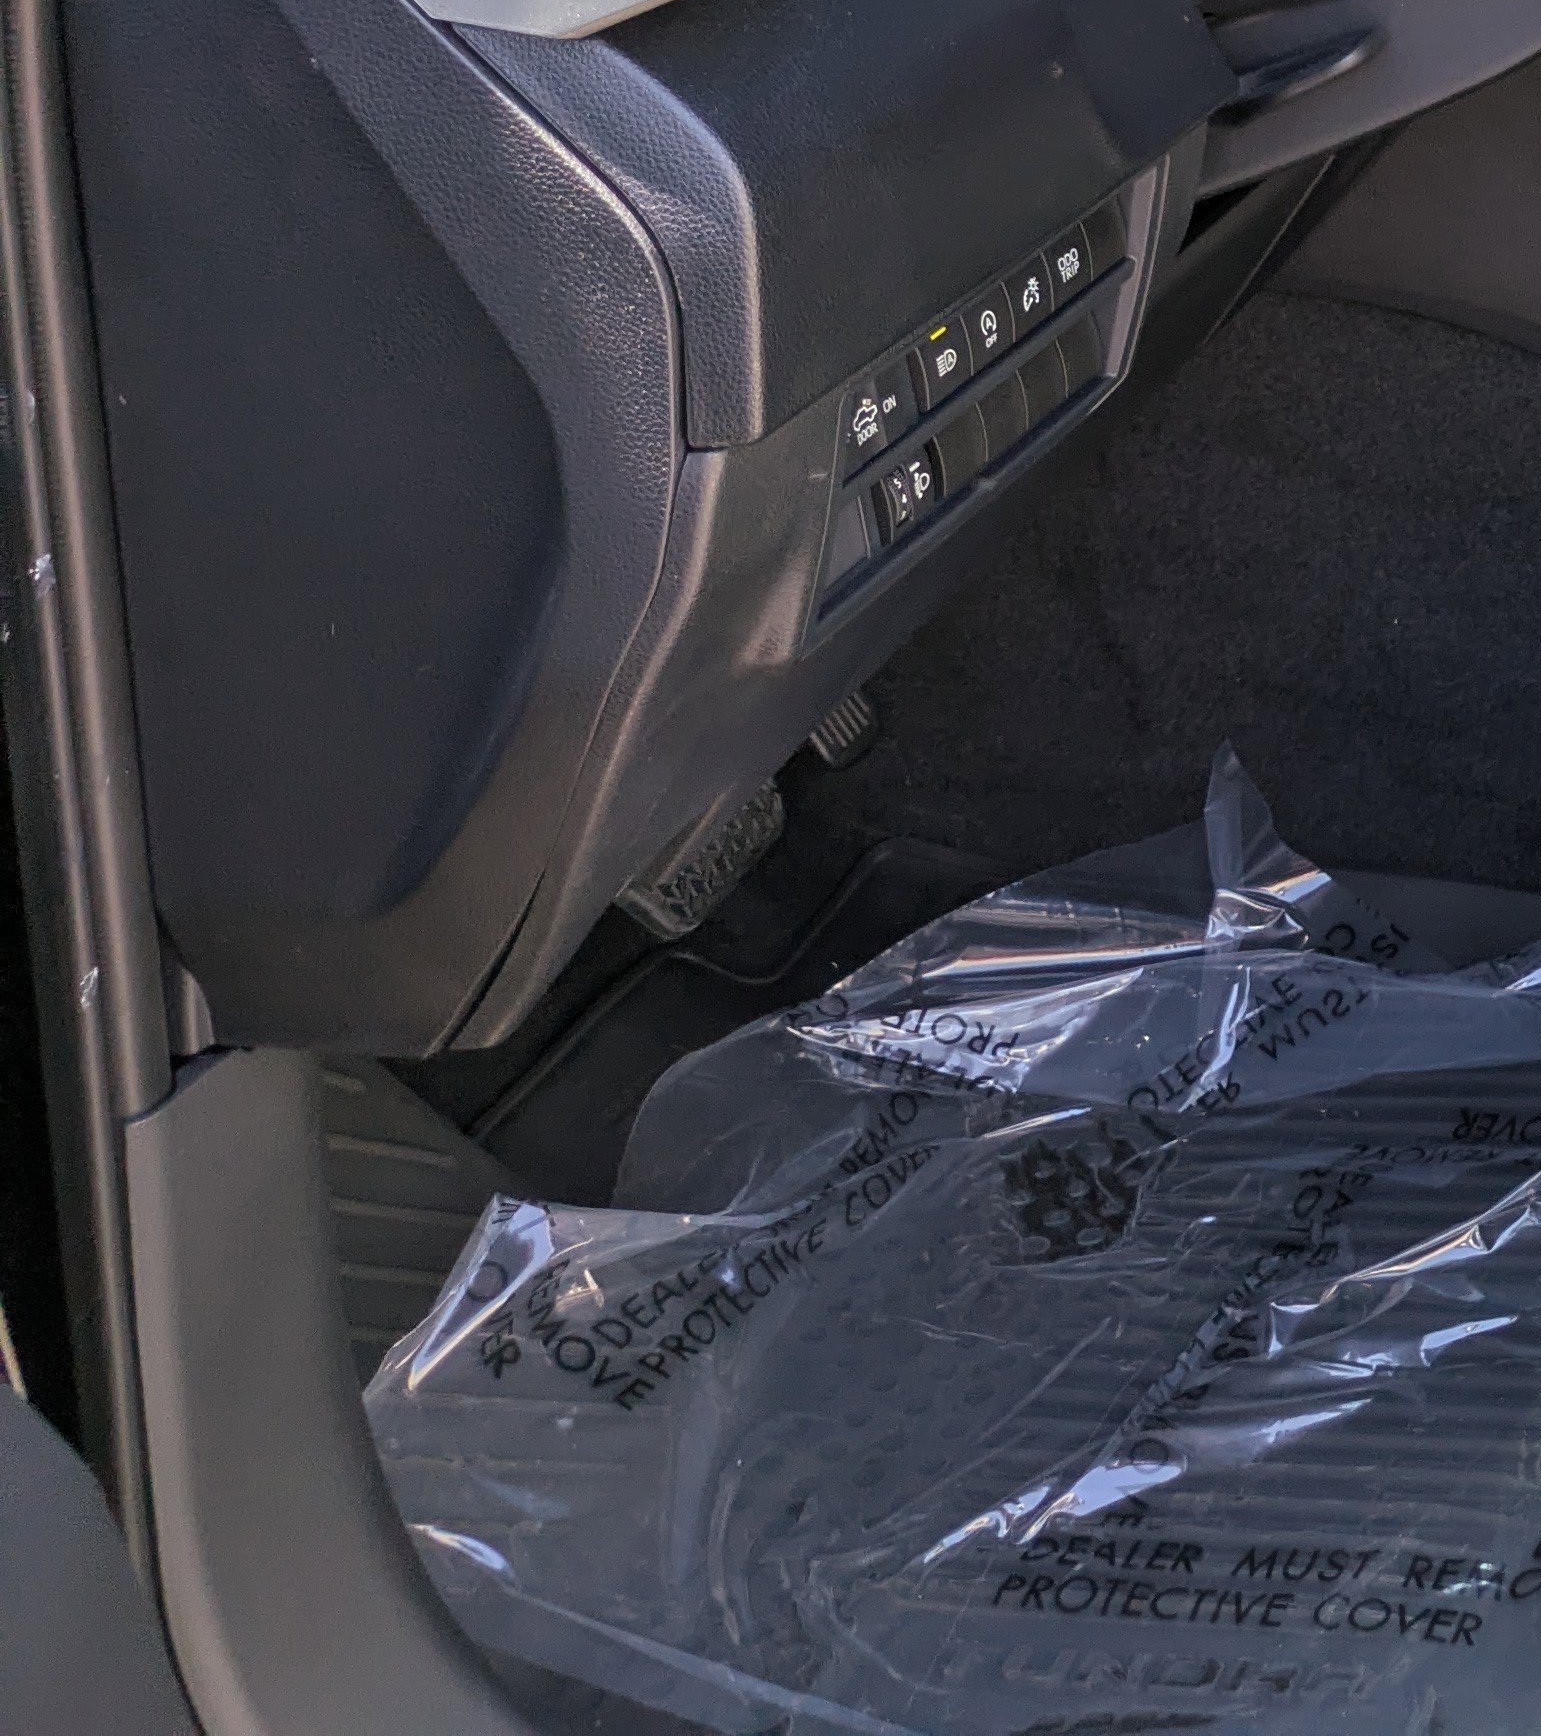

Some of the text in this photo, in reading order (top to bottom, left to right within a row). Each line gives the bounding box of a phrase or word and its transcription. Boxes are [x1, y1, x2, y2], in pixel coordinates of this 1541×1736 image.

[1058, 247, 1078, 271] ODO
[1061, 260, 1080, 283] TRIP
[986, 332, 998, 348] OFF
[883, 394, 897, 413] ON
[857, 422, 879, 446] DOOR
[638, 1218, 828, 1378] PROTECTIVE
[1019, 1533, 1205, 1574] DEALER
[1230, 1545, 1382, 1583] MUST
[992, 1571, 1484, 1647] PROTECTIVE COVER
